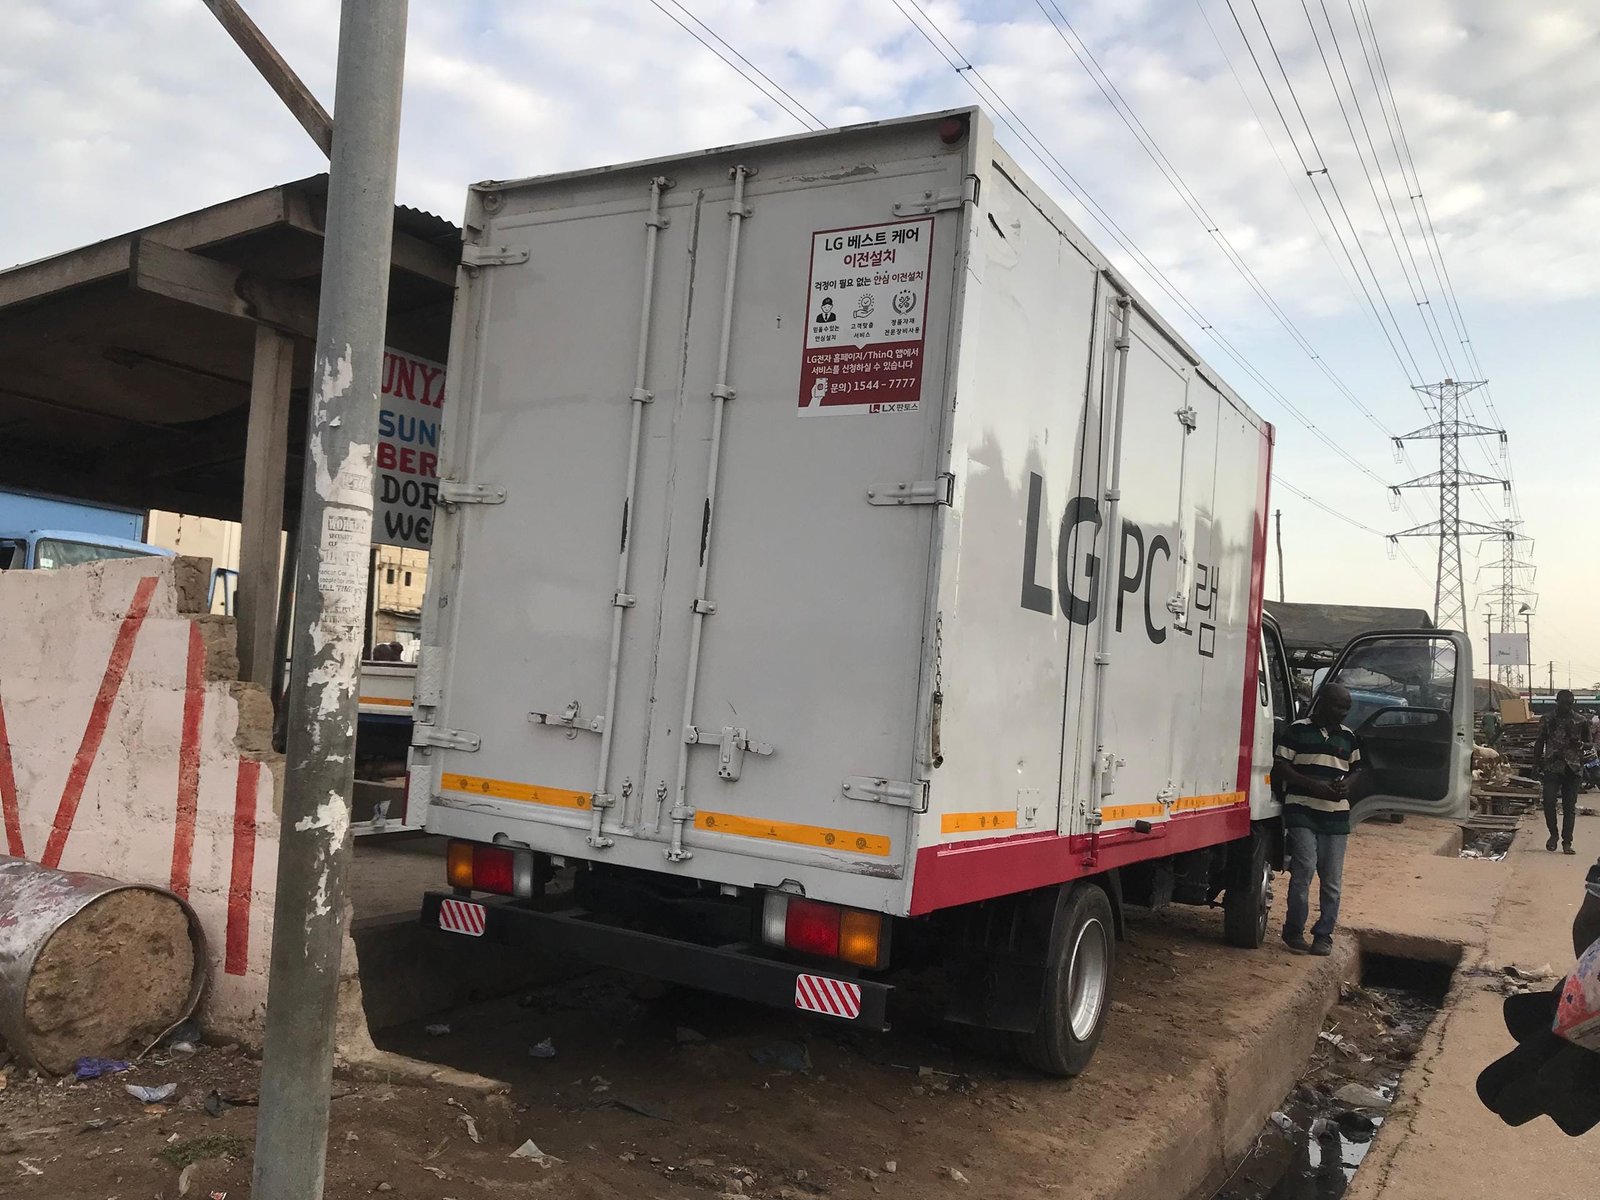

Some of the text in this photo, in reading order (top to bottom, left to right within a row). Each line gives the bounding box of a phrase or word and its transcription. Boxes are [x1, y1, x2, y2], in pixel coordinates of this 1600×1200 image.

[825, 227, 919, 251] LG 베스트 케어
[844, 249, 896, 268] 이전설치
[815, 271, 924, 291] 걱정이 필요 없는 안심 이전설치
[806, 347, 919, 364] LG전자 홈페이지/ThinQ 앱에서
[811, 359, 914, 375] 서비스를 신청하실 수 있습니다
[384, 510, 433, 545] WE
[1020, 471, 1103, 626] LG
[1115, 517, 1171, 645] PC
